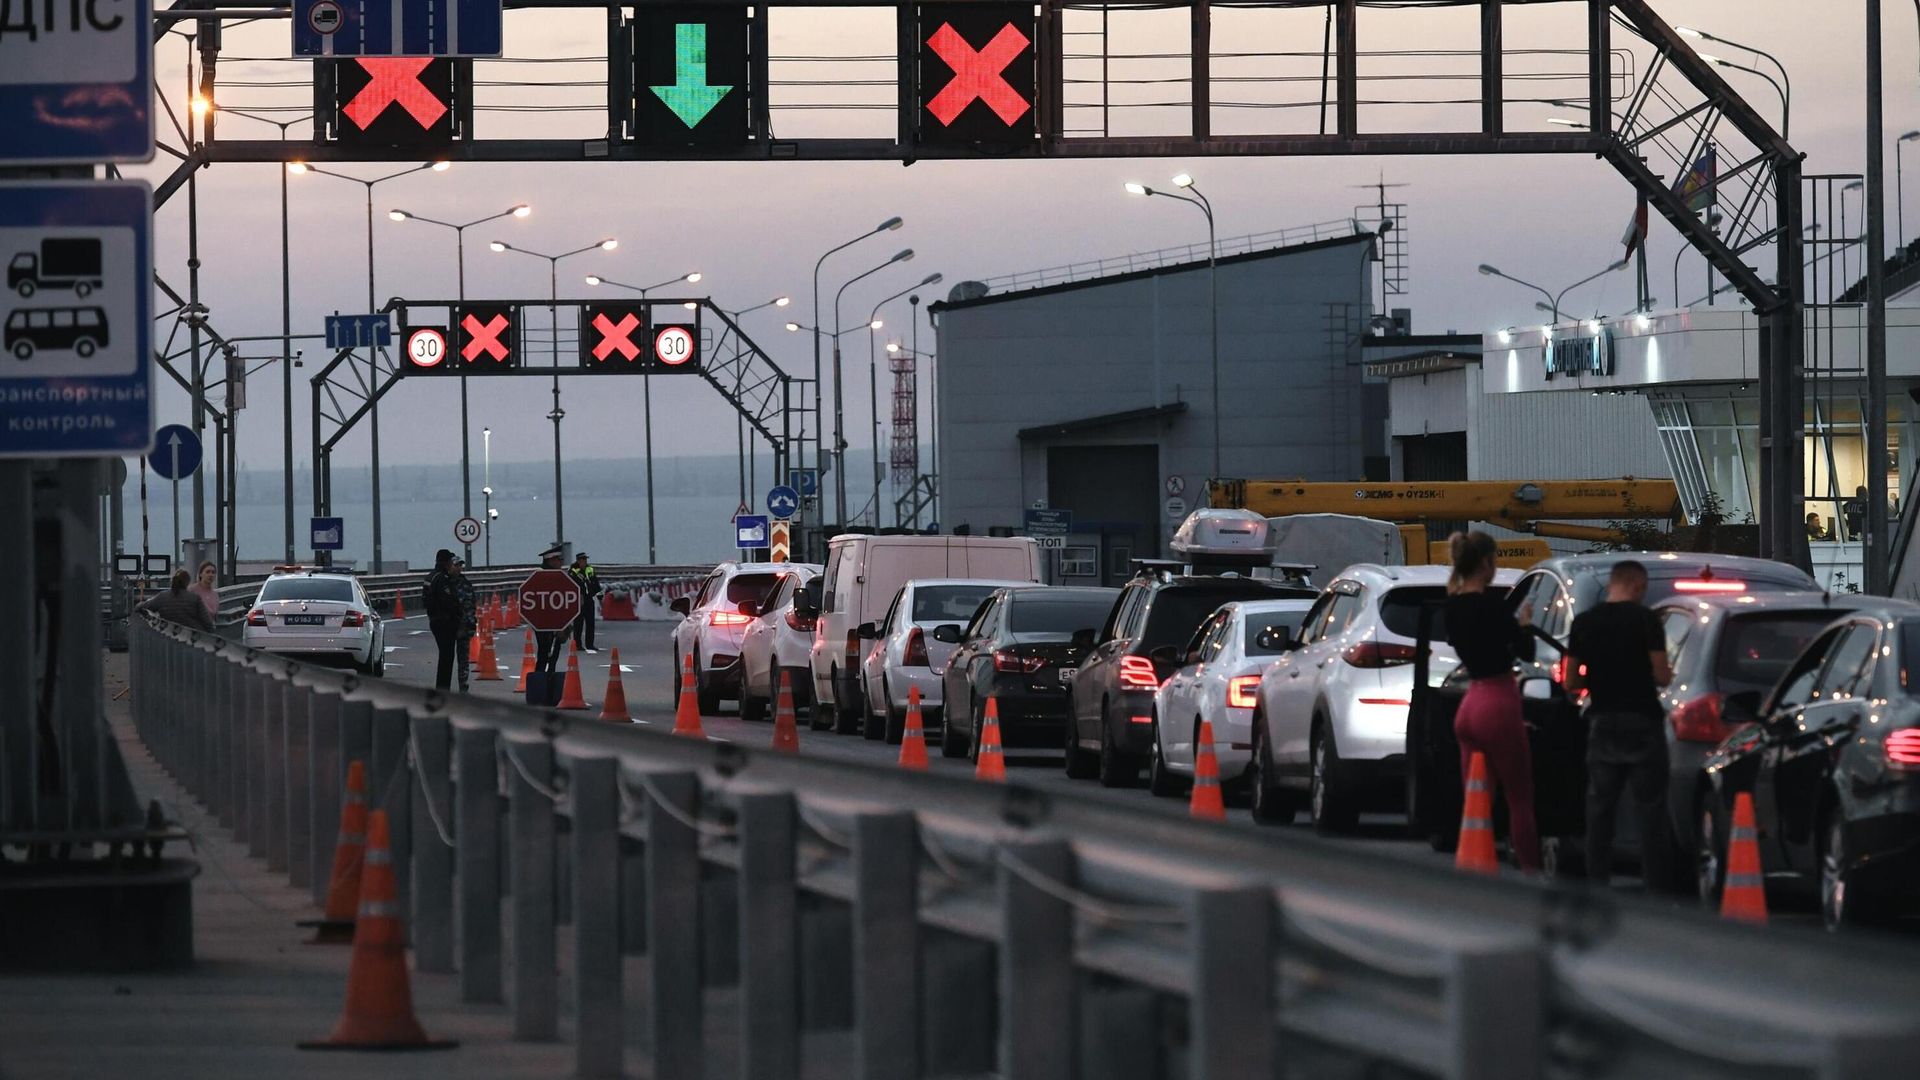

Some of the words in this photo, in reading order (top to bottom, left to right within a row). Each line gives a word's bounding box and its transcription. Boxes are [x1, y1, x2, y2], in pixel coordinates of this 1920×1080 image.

[416, 339, 437, 357] 30
[664, 337, 685, 355] 30
[9, 415, 116, 433] контроль
[461, 524, 476, 536] 30
[522, 590, 578, 610] STOP
